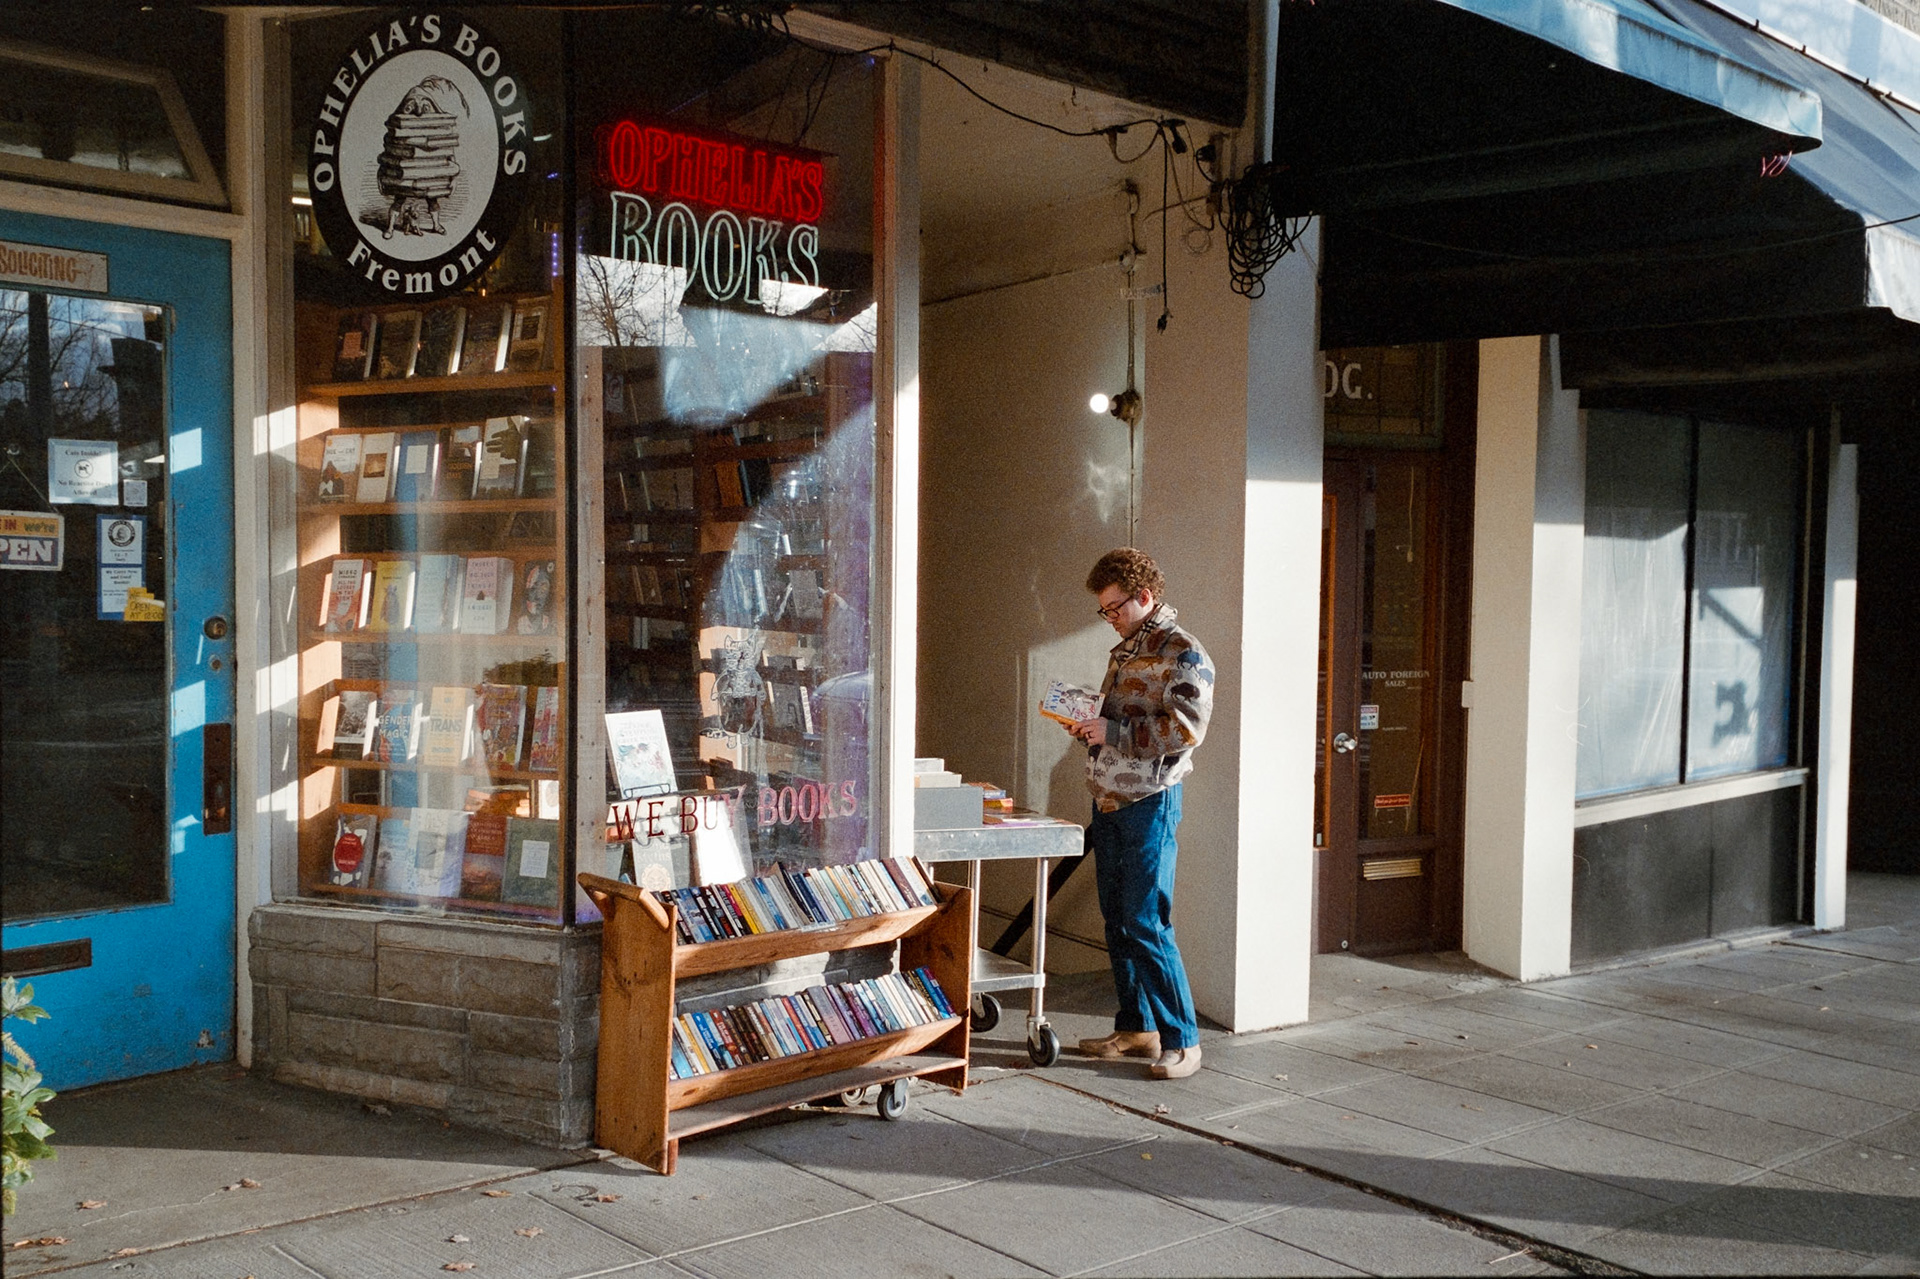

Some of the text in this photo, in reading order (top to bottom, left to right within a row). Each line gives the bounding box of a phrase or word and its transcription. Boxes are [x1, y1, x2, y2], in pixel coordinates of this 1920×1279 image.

[314, 14, 527, 192] OPHELIA'S BOOKS
[610, 120, 823, 222] OPHELIA'S
[0, 244, 79, 284] SOLICITING
[347, 228, 496, 294] Fremont
[610, 191, 819, 306] BOOKS
[5, 519, 17, 531] IN
[1361, 670, 1430, 679] AUTO FOREIGN
[379, 729, 409, 739] MAGIC
[430, 719, 461, 732] TRANS
[612, 780, 857, 840] WE BUY BOOKS
